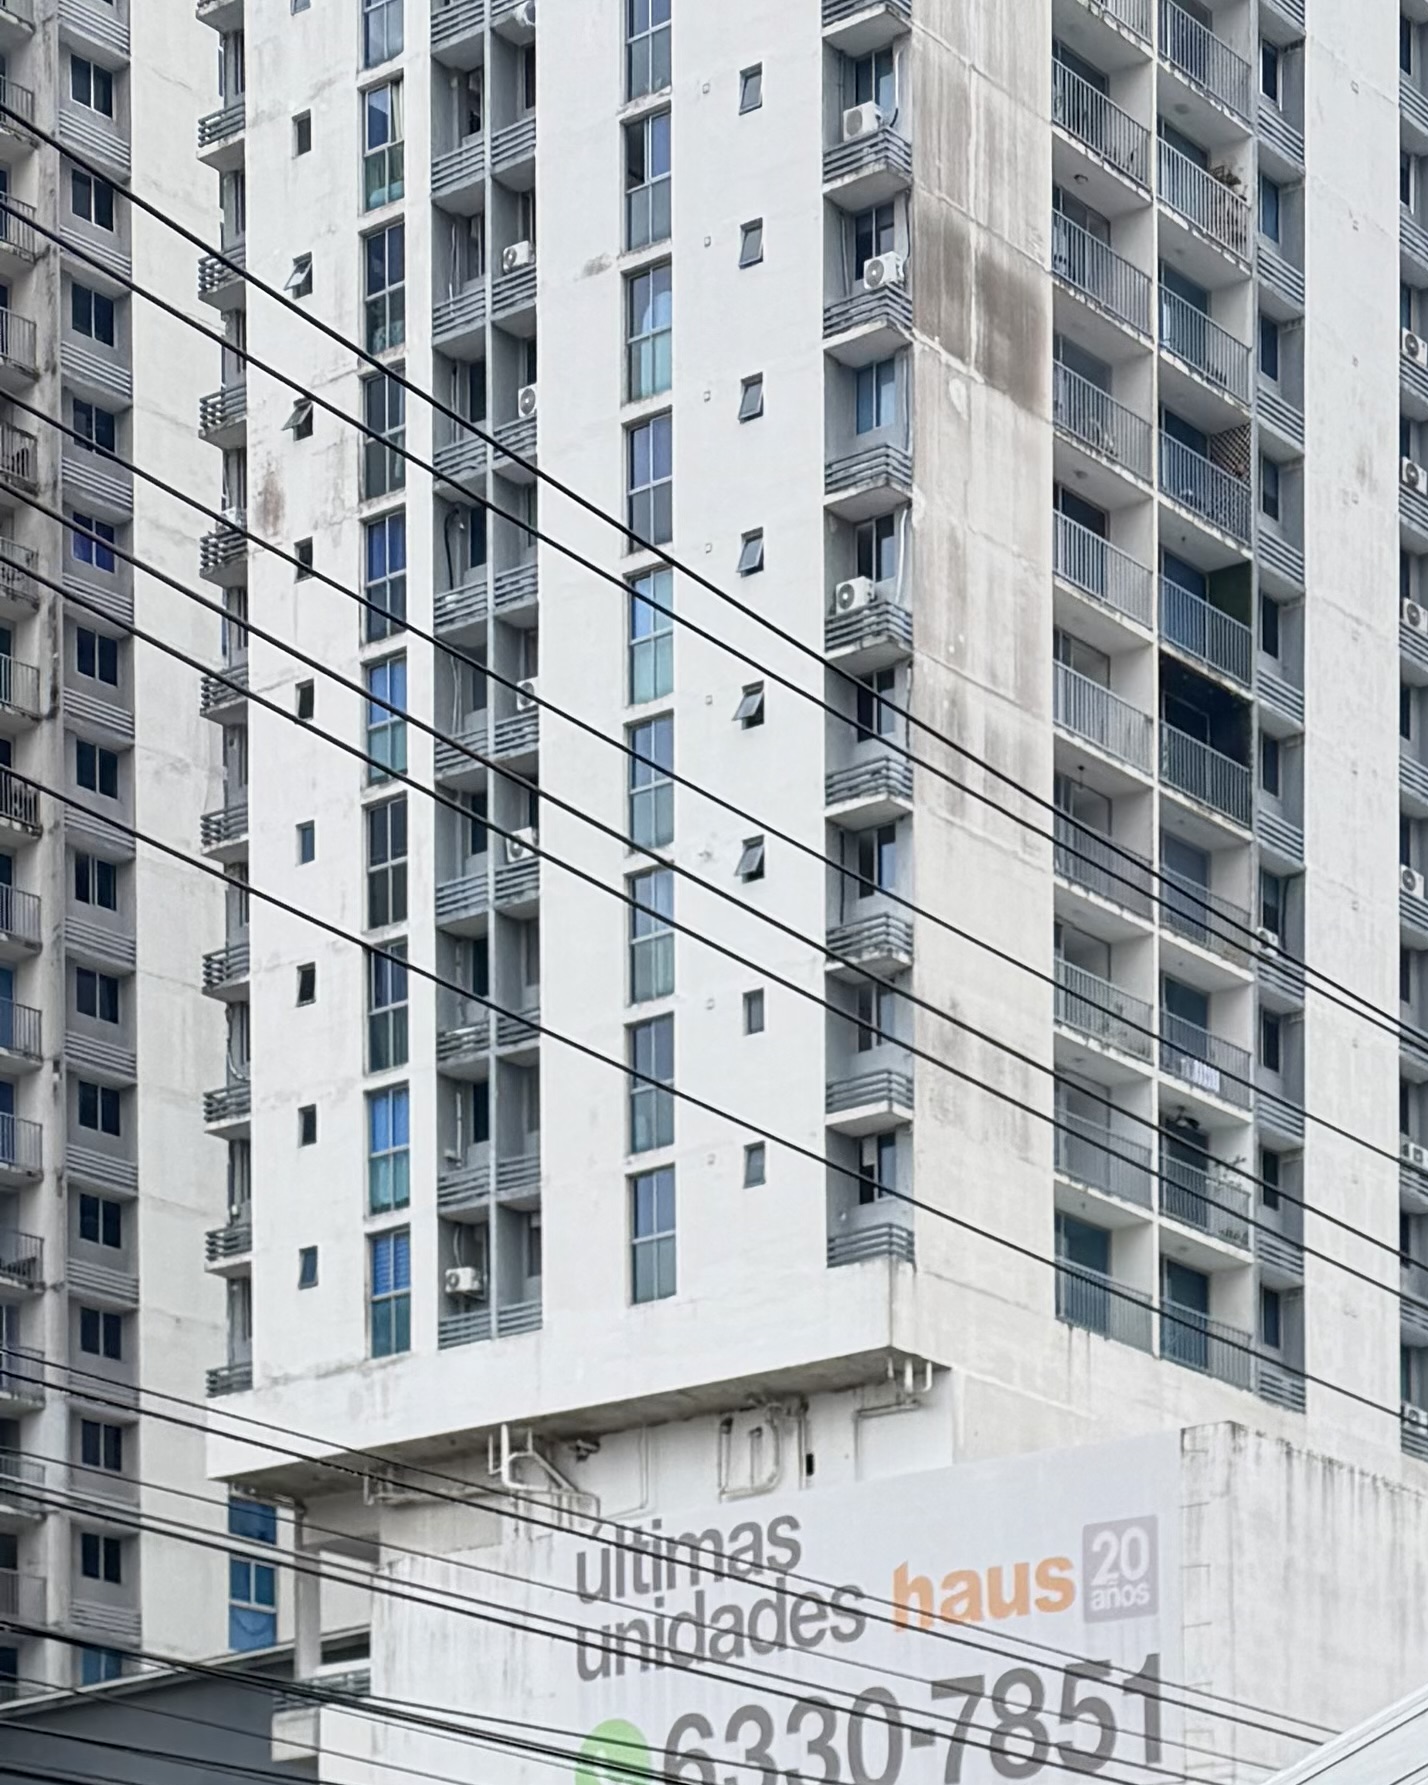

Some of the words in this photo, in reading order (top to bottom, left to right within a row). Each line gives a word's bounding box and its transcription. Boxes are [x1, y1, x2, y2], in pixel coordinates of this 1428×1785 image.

[576, 1515, 802, 1605] últimas
[892, 1556, 1077, 1634] haus
[1089, 1525, 1151, 1588] 20
[1091, 1577, 1151, 1612] años
[576, 1577, 867, 1682] unidades
